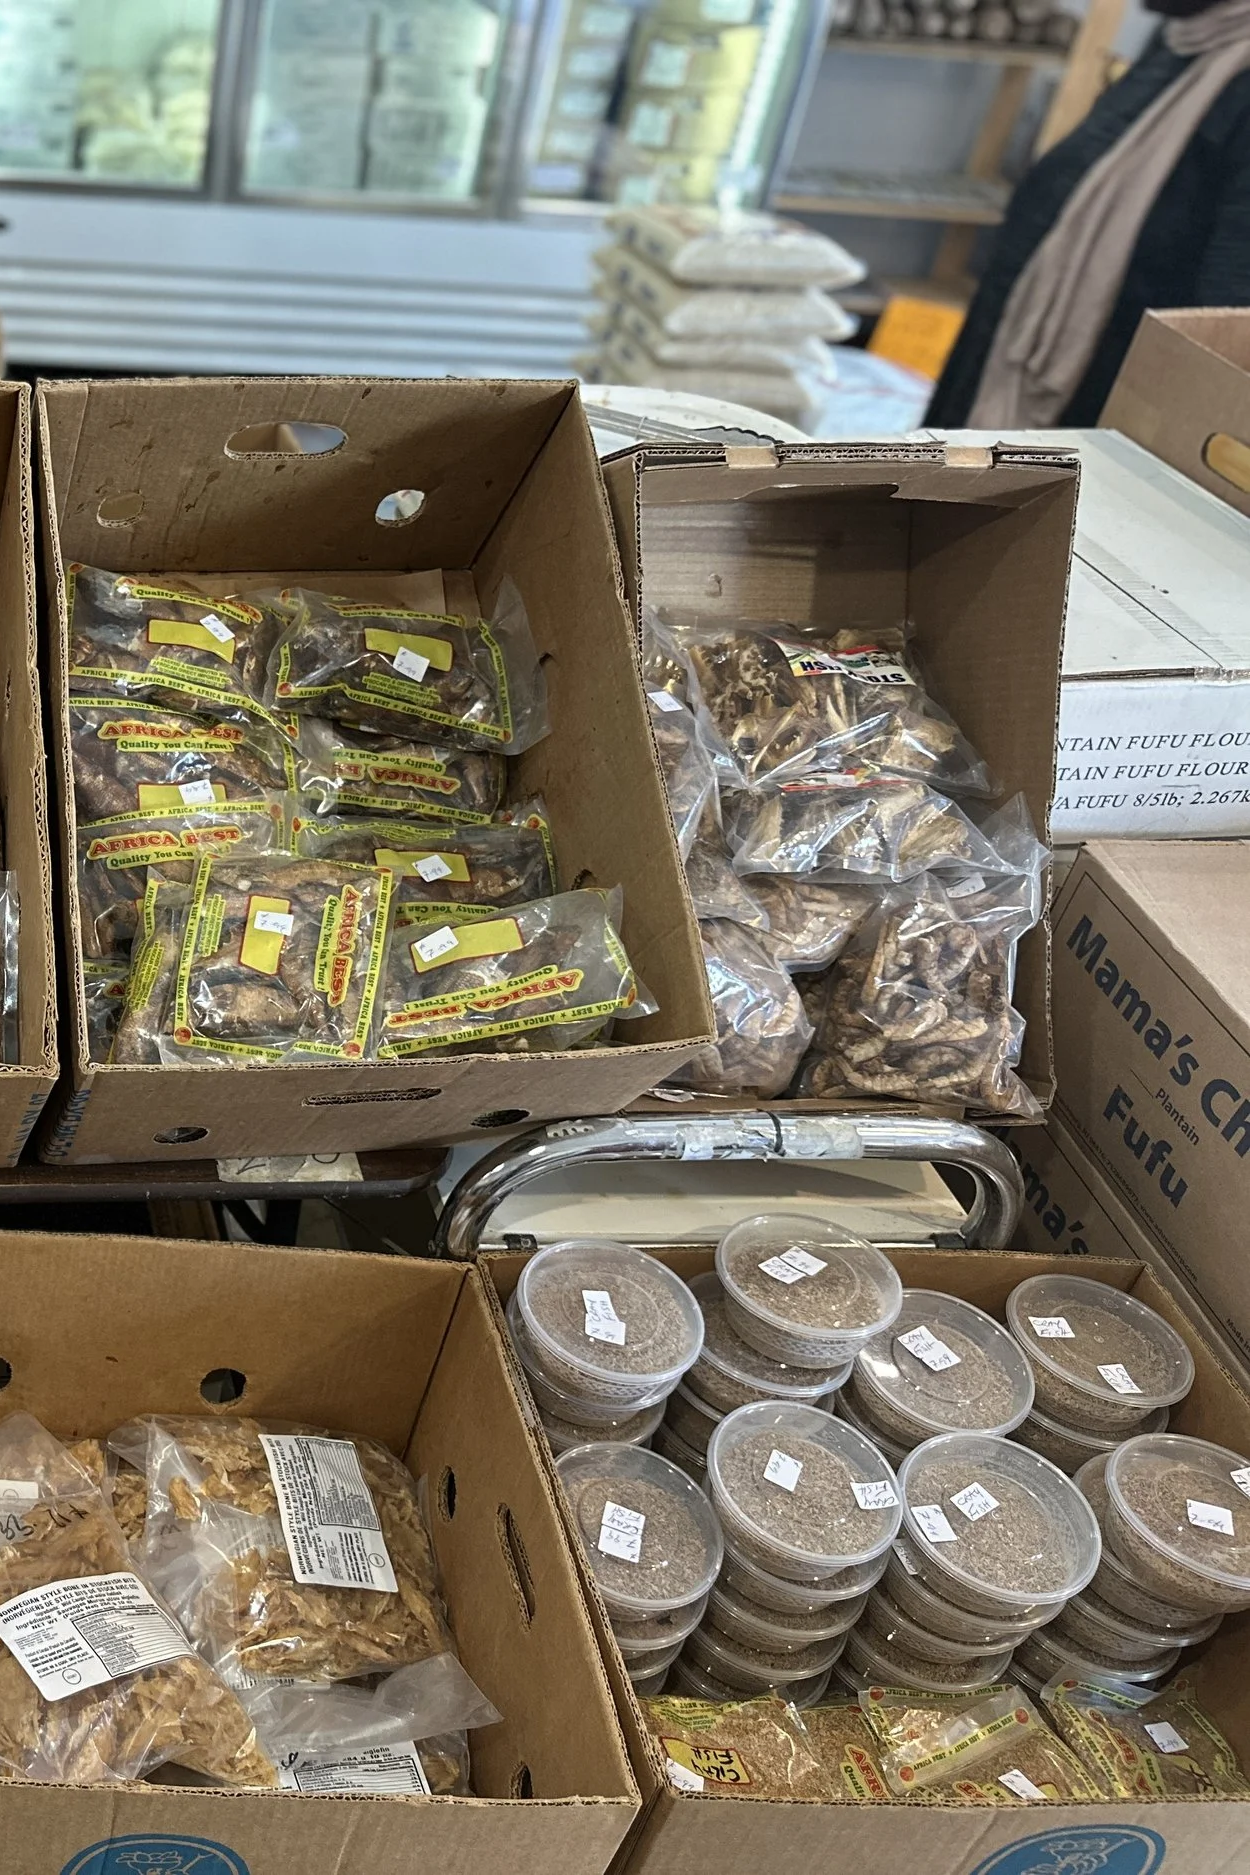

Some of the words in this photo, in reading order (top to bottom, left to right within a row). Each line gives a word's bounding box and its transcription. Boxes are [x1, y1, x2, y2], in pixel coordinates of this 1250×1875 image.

[106, 722, 187, 738] AFRICA
[210, 723, 244, 740] EST
[120, 740, 160, 751] Quality
[163, 741, 182, 750] You
[183, 740, 202, 749] Can
[1125, 734, 1187, 750] FUFU
[1113, 764, 1173, 779] FUFU
[1175, 761, 1249, 777] FLOUR
[372, 766, 460, 793] AFRICA
[1075, 794, 1128, 810] FUFU
[110, 813, 136, 824] AFRICA
[138, 810, 156, 818] BEST
[92, 832, 178, 855] AFRICA
[110, 854, 151, 868] Quality
[153, 851, 172, 861] You
[174, 850, 194, 859] Can
[408, 904, 430, 914] Can
[337, 887, 361, 953] AFRICA
[371, 951, 379, 972] AFRICA
[177, 971, 187, 998] AFRICA
[470, 971, 578, 1010] AFRICA
[481, 983, 503, 996] You
[360, 995, 371, 1019] AFRICA
[1066, 914, 1200, 1087] Mama's
[176, 1003, 184, 1022] BEST
[389, 1005, 461, 1025] BEST
[523, 1013, 555, 1026] AFRICA
[571, 1007, 593, 1018] BEST
[356, 1021, 365, 1039] BEST
[451, 1027, 484, 1040] AFRICA
[498, 1021, 521, 1032] BEST
[426, 1035, 449, 1046] BEST
[1154, 1087, 1201, 1147] Plantain
[1102, 1084, 1190, 1209] Fufu
[284, 1491, 293, 1510] BONE
[288, 1510, 298, 1534] STYLE
[294, 1505, 303, 1526] STYLE
[292, 1534, 308, 1575] NORWEGIAN
[41, 1588, 62, 1601] STYLE
[63, 1583, 80, 1593] BONE
[54, 1593, 74, 1606] STYLE
[913, 1757, 933, 1771] AFRICA
[986, 1723, 1001, 1735] AFRICA
[1001, 1714, 1015, 1726] BEST
[691, 1748, 734, 1765] FISH
[691, 1759, 741, 1783] CRAY
